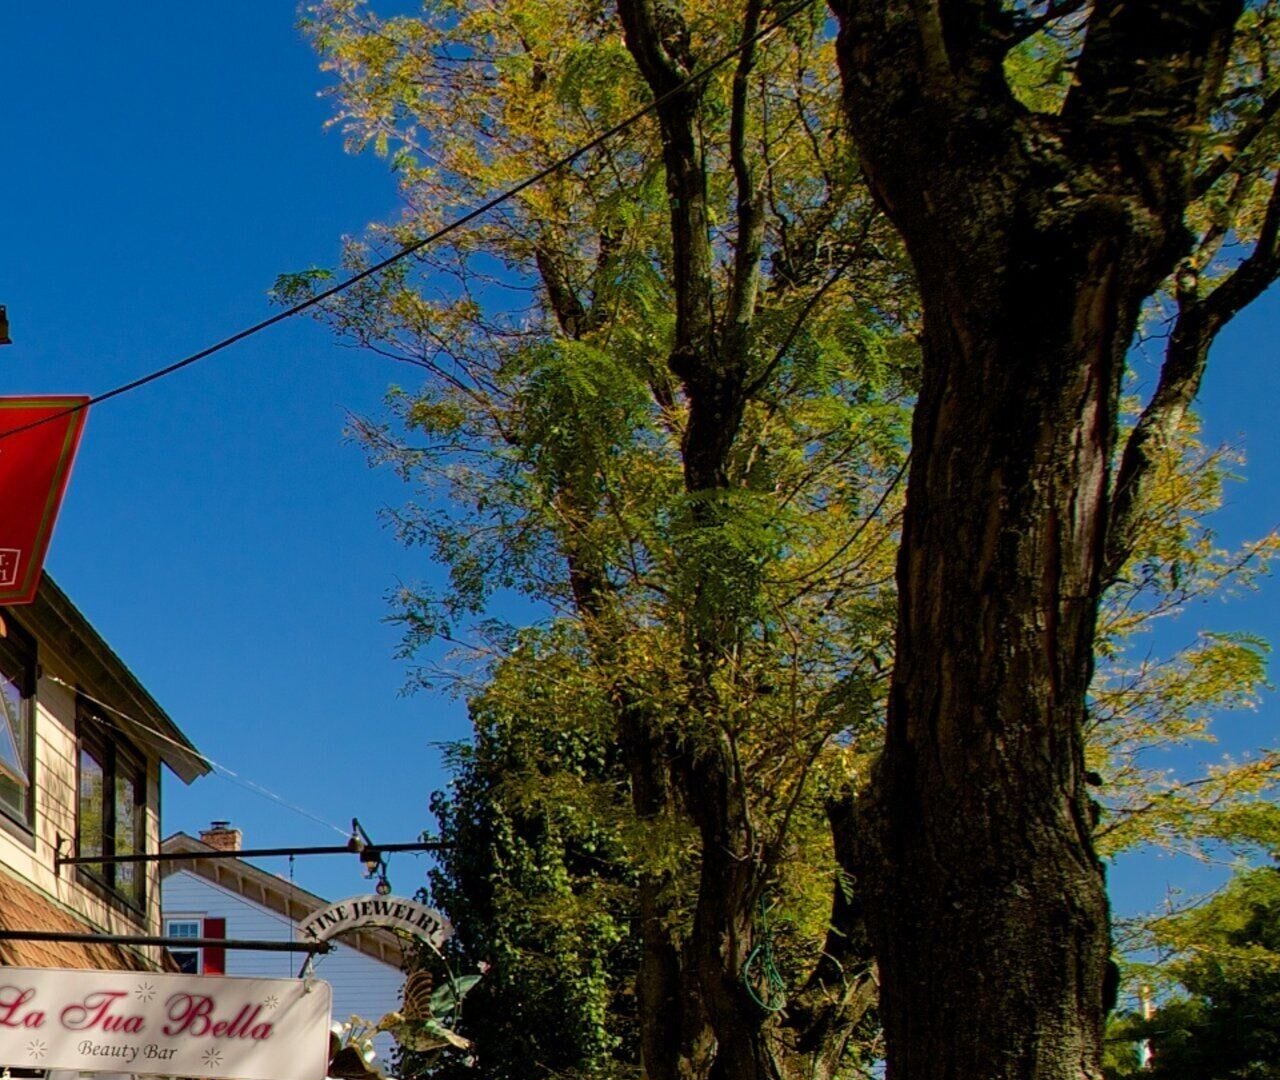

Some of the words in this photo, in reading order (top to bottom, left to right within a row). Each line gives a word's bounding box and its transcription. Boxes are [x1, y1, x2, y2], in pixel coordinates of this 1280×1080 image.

[305, 906, 349, 938] FINE
[351, 900, 445, 937] JEWELRY
[60, 991, 144, 1034] Tua
[162, 993, 275, 1041] Bella
[78, 1041, 140, 1063] Beauty
[143, 1043, 178, 1061] Bar
